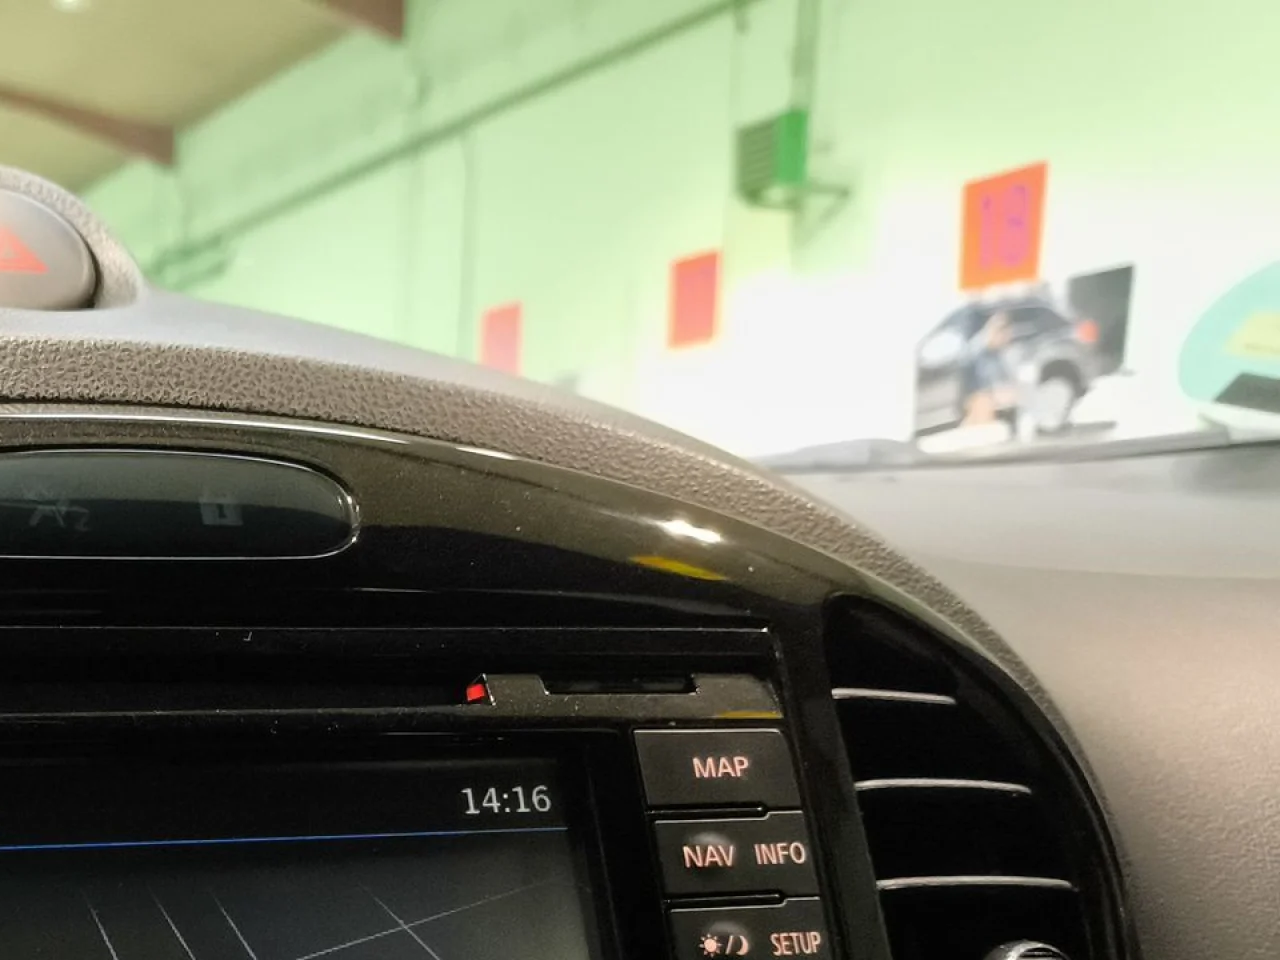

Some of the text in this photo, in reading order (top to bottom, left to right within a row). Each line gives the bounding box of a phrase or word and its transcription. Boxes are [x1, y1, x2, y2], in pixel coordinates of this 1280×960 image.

[692, 756, 749, 778] MAP
[461, 785, 552, 815] 14:16
[683, 844, 735, 868] NAV
[754, 842, 807, 865] INFO
[770, 931, 821, 956] SETUP
